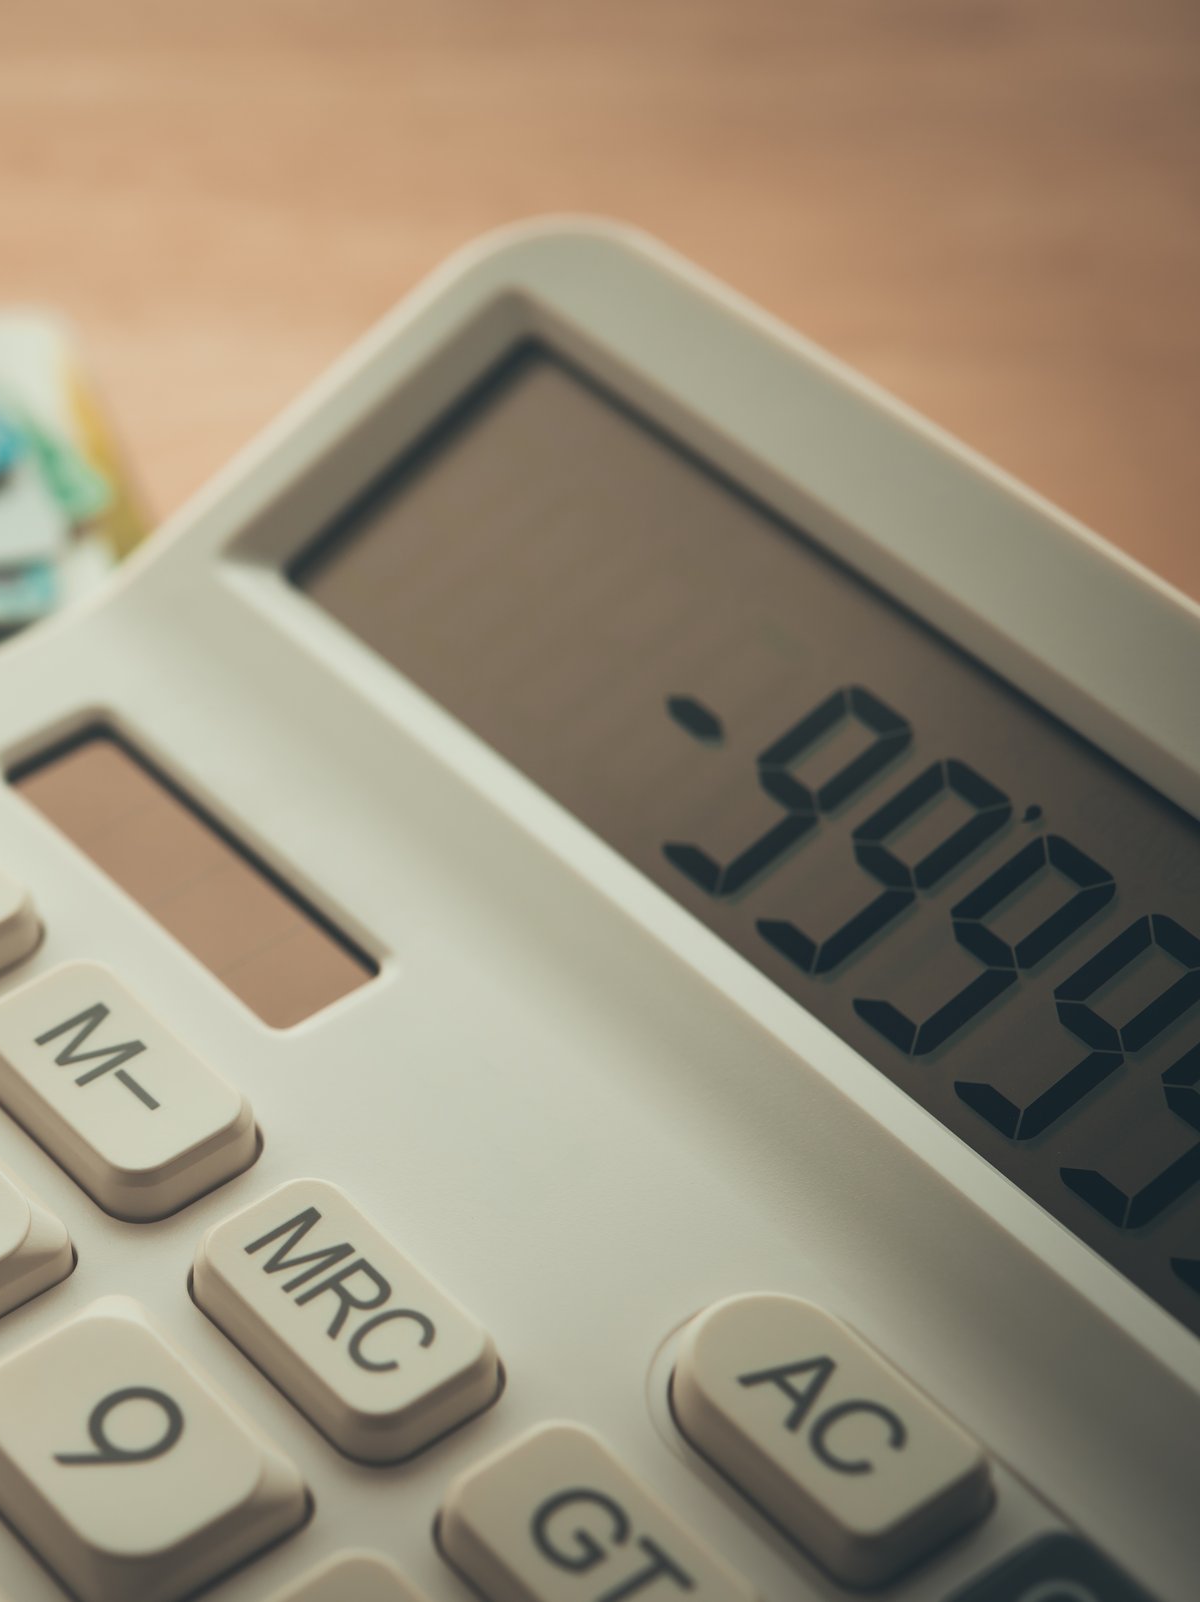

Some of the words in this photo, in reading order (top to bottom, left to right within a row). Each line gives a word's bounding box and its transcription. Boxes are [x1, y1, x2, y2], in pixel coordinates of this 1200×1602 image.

[34, 1001, 161, 1111] M-
[243, 1206, 436, 1373] MRC
[53, 1386, 185, 1466] 9
[736, 1355, 908, 1476] AC
[530, 1486, 696, 1602] GT
